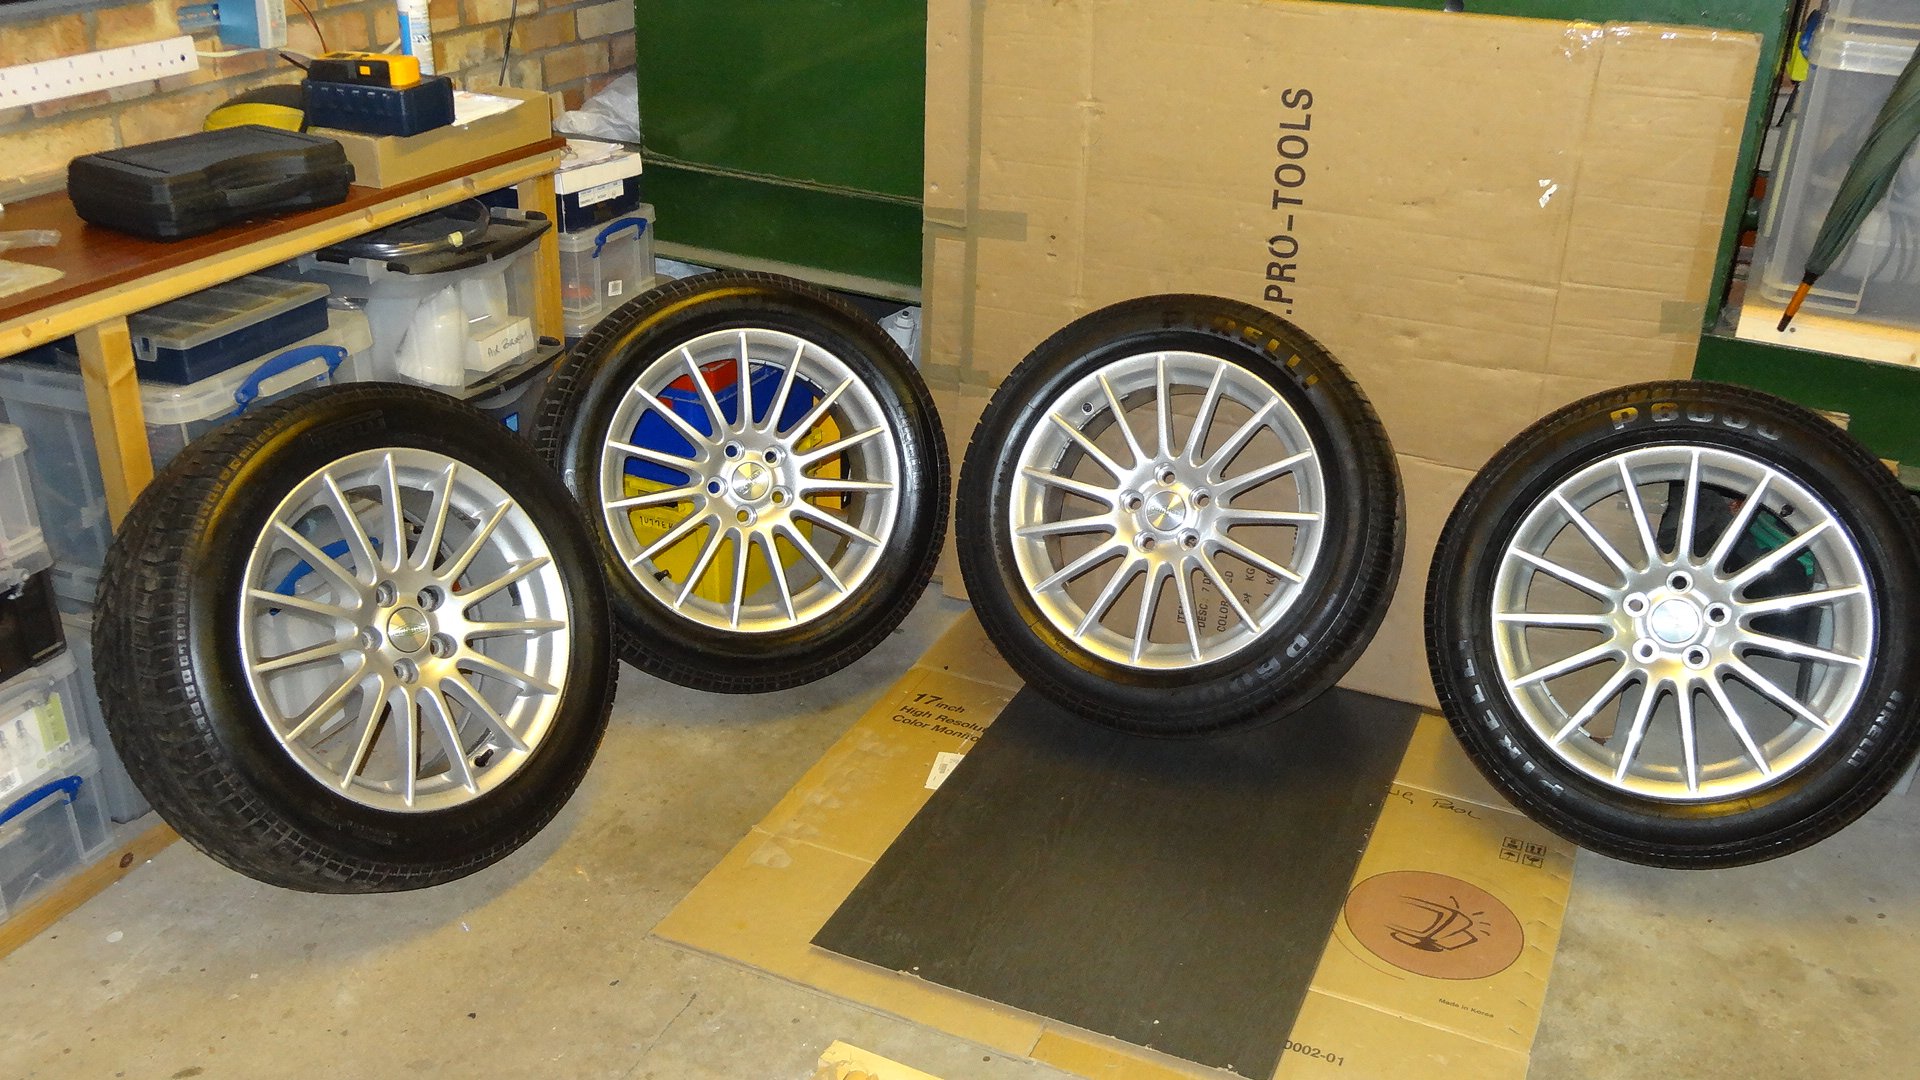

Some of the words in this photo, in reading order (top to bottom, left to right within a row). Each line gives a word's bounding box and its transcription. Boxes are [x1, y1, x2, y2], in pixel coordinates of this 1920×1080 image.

[1216, 600, 1229, 632] COLOR
[899, 705, 933, 719] High
[892, 714, 931, 729] Color
[930, 724, 981, 743] Monito
[1439, 998, 1460, 1008] Made
[1470, 1007, 1495, 1018] Korea
